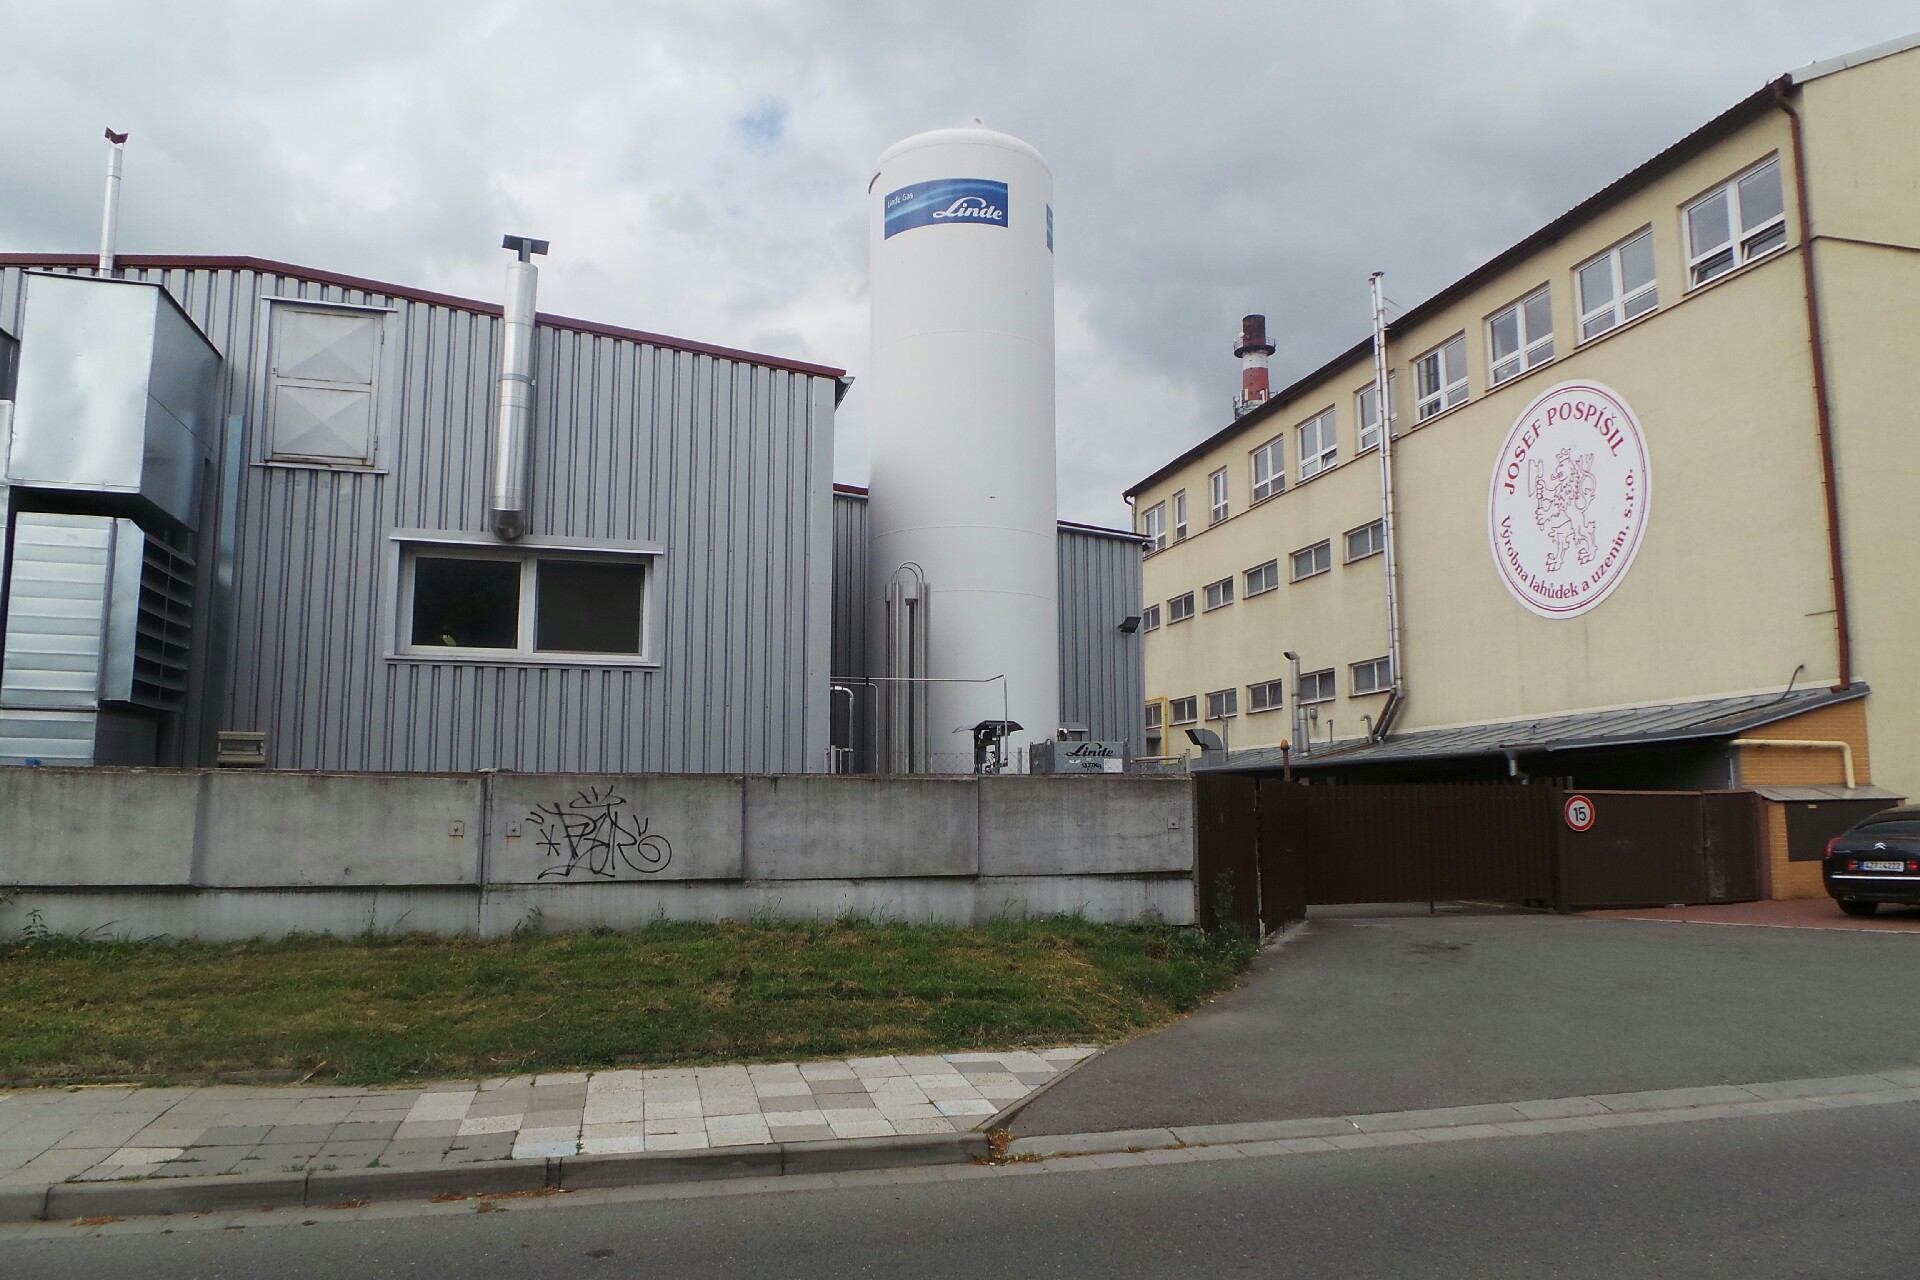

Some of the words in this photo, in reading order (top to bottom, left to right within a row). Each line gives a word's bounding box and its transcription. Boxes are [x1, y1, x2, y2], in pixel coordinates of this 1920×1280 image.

[902, 191, 914, 203] Gas
[932, 196, 1003, 220] Linde
[1504, 418, 1541, 495] JOSEF
[1546, 401, 1624, 457] POSPÍŠIL
[1500, 515, 1529, 582] Výrobna
[1529, 574, 1579, 599] lahůdek
[1582, 580, 1590, 592] a
[1624, 468, 1635, 519] s.r.o.
[1065, 742, 1114, 757] Linde
[1573, 806, 1587, 822] 15
